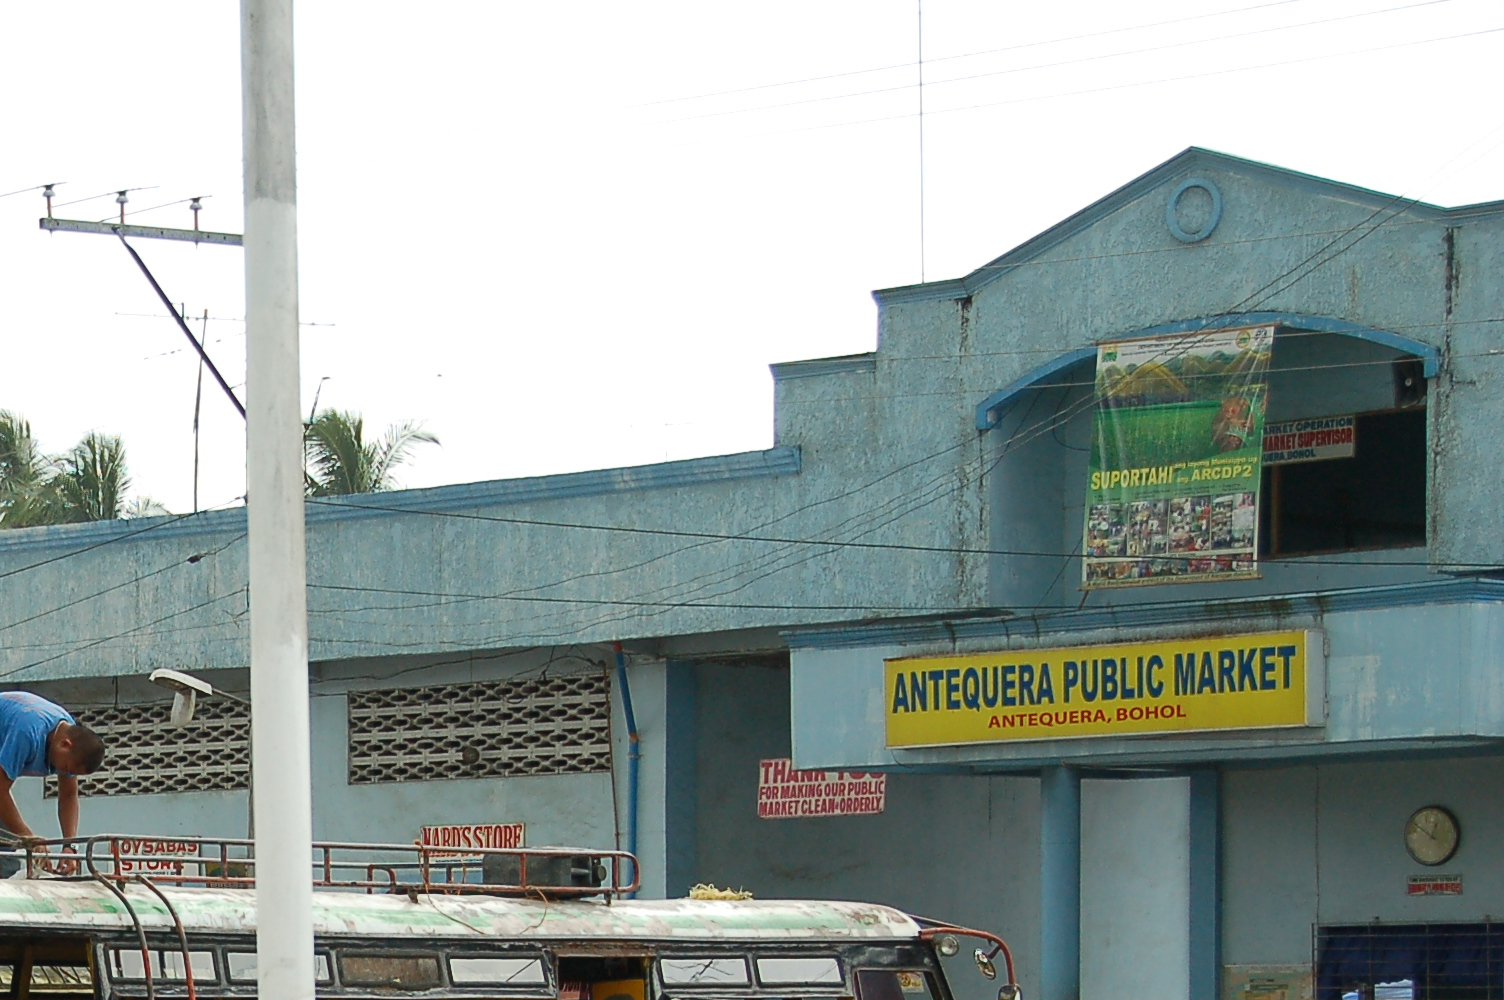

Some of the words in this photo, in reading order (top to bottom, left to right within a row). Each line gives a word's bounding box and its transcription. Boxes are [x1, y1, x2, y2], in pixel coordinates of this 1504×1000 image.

[1264, 424, 1294, 434] ARKET
[1297, 417, 1353, 431] OPERATION
[1298, 427, 1353, 448] SUPERVISOR
[1288, 449, 1316, 460] BOHOL
[1091, 466, 1173, 490] SUPORTAHI
[1191, 465, 1253, 481] ARCDP2
[892, 663, 1055, 714] ANTEQUERA
[1063, 655, 1164, 704] PUBLIC
[1173, 645, 1297, 697] MARKET
[988, 709, 1113, 729] ANTEQUERA,
[1116, 704, 1187, 722] BOHOL
[759, 786, 779, 800] FOR
[780, 784, 823, 799] MAKING
[825, 782, 846, 796] OUR
[847, 781, 885, 796] PUBLIC
[759, 800, 800, 816] MARKET
[473, 823, 523, 857] STORE
